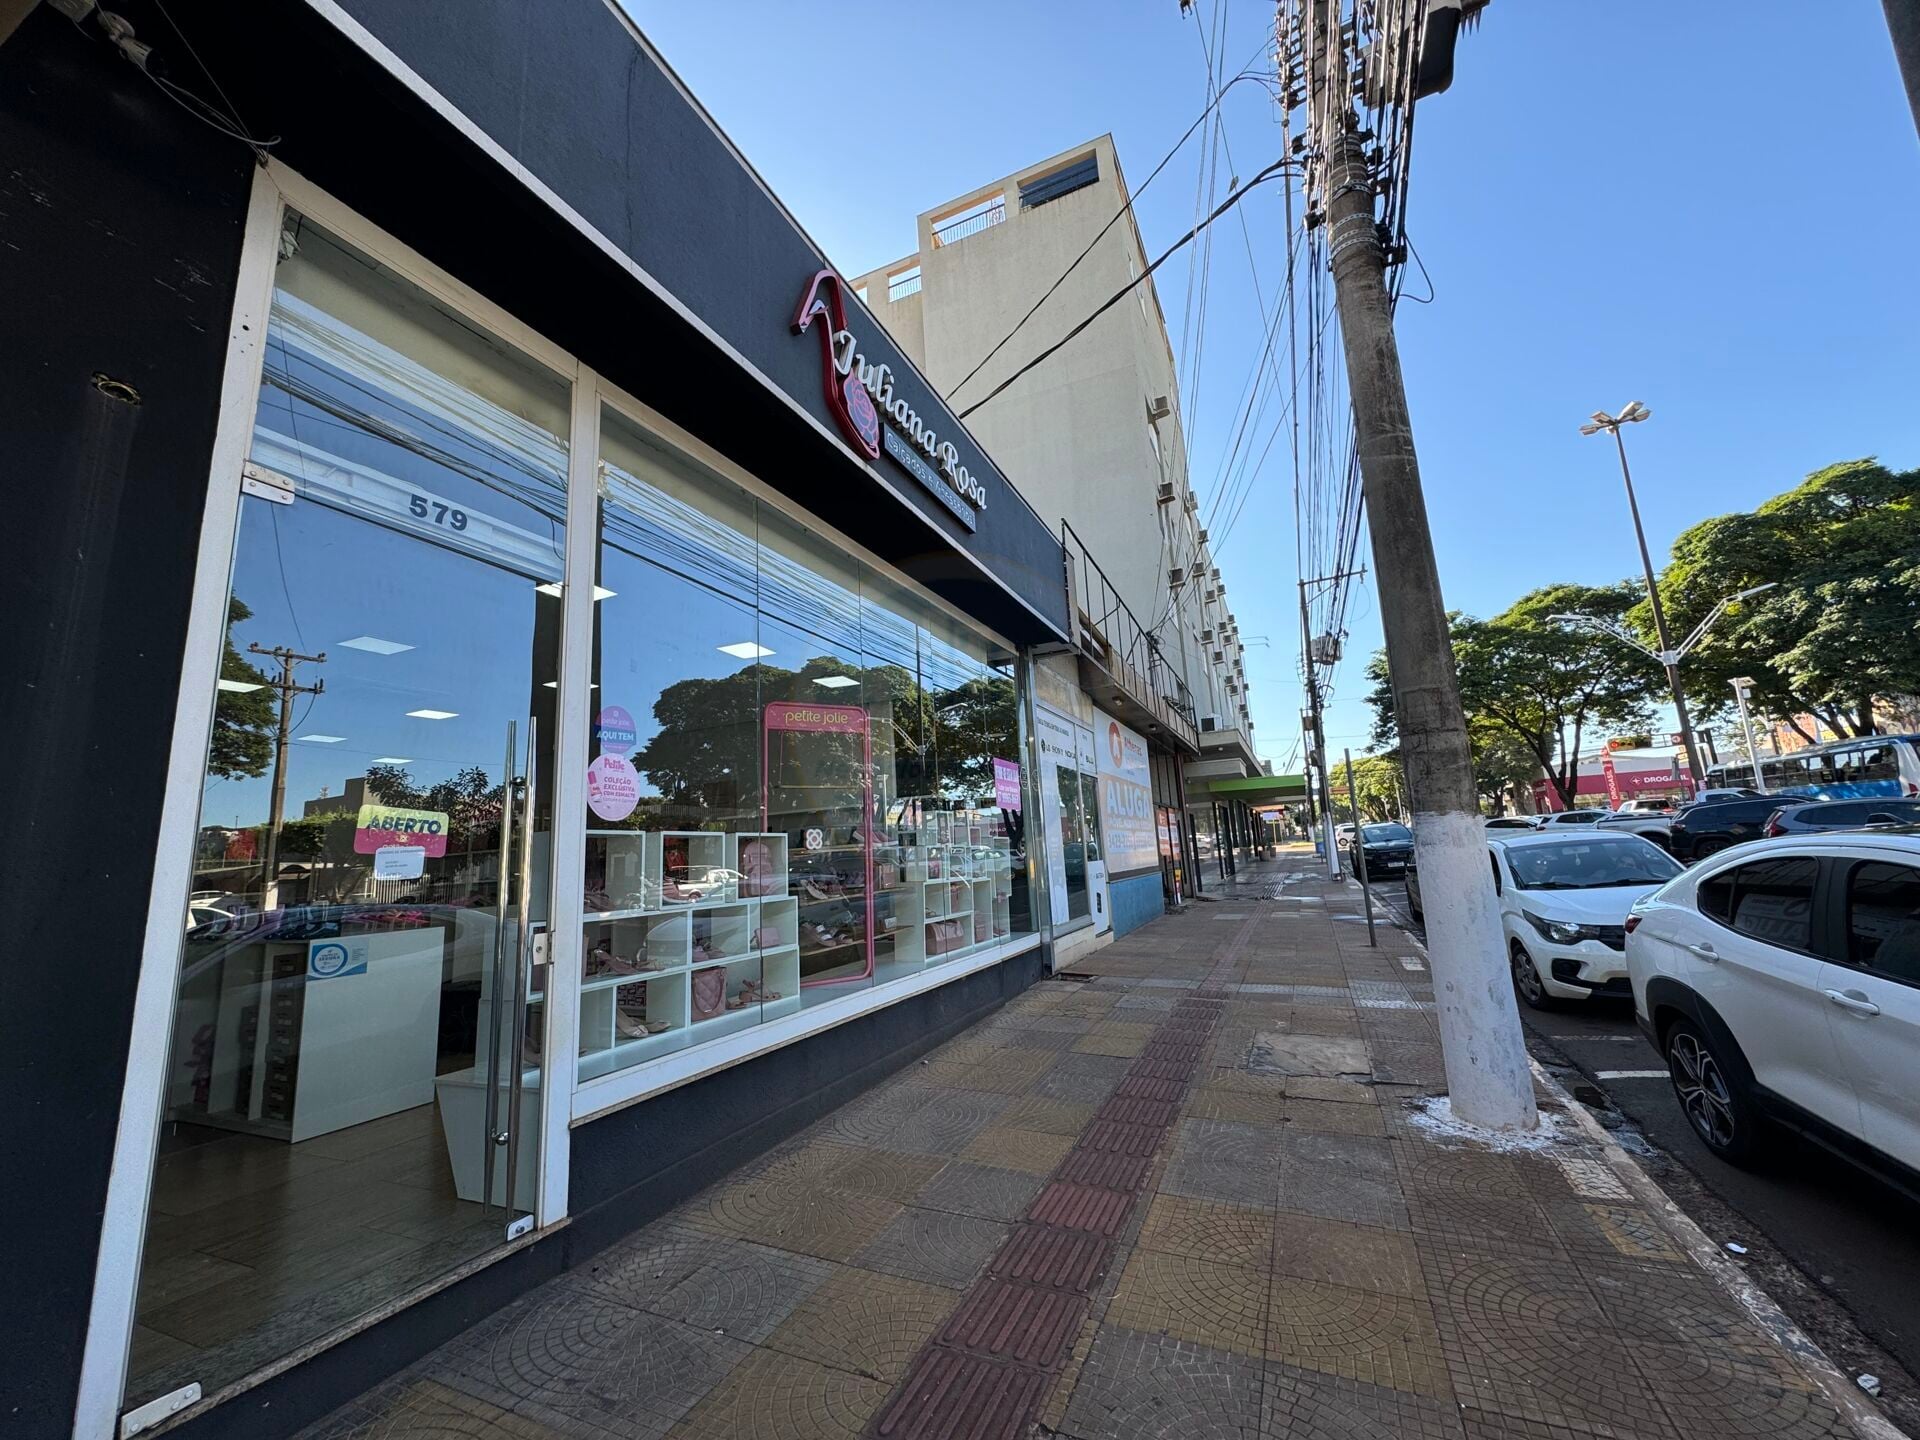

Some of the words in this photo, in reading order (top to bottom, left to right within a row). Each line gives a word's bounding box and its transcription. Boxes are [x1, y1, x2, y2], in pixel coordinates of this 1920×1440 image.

[834, 330, 938, 457] Juliana
[942, 441, 988, 510] Rosa
[408, 493, 468, 531] 579
[785, 710, 821, 726] petite
[823, 711, 848, 725] jolie
[618, 731, 634, 741] TEM
[1106, 778, 1152, 818] ALUGA
[366, 815, 442, 835] ABERTO
